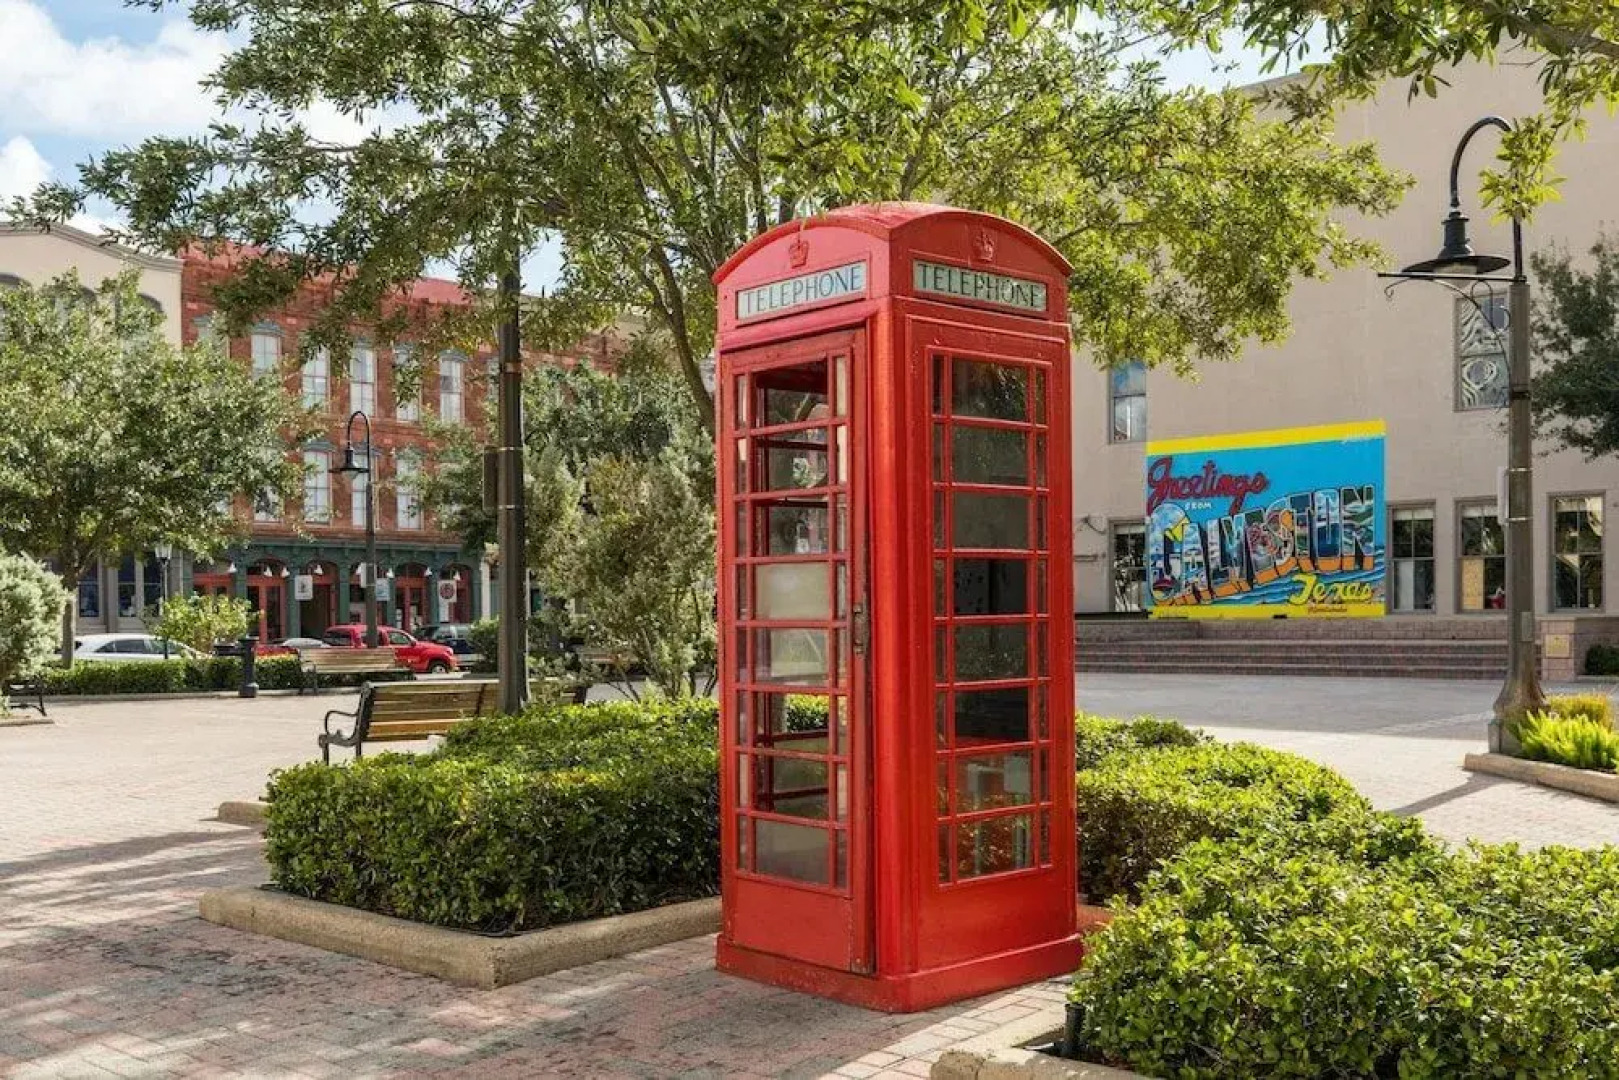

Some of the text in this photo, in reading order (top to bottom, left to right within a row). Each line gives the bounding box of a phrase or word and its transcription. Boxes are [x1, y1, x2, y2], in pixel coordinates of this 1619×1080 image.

[742, 264, 863, 314] TELEPHONE
[917, 263, 1041, 308] TELEPHONE
[1147, 456, 1269, 516] Greetings
[1149, 484, 1375, 606] GALVESTON
[1289, 573, 1373, 605] Texas
